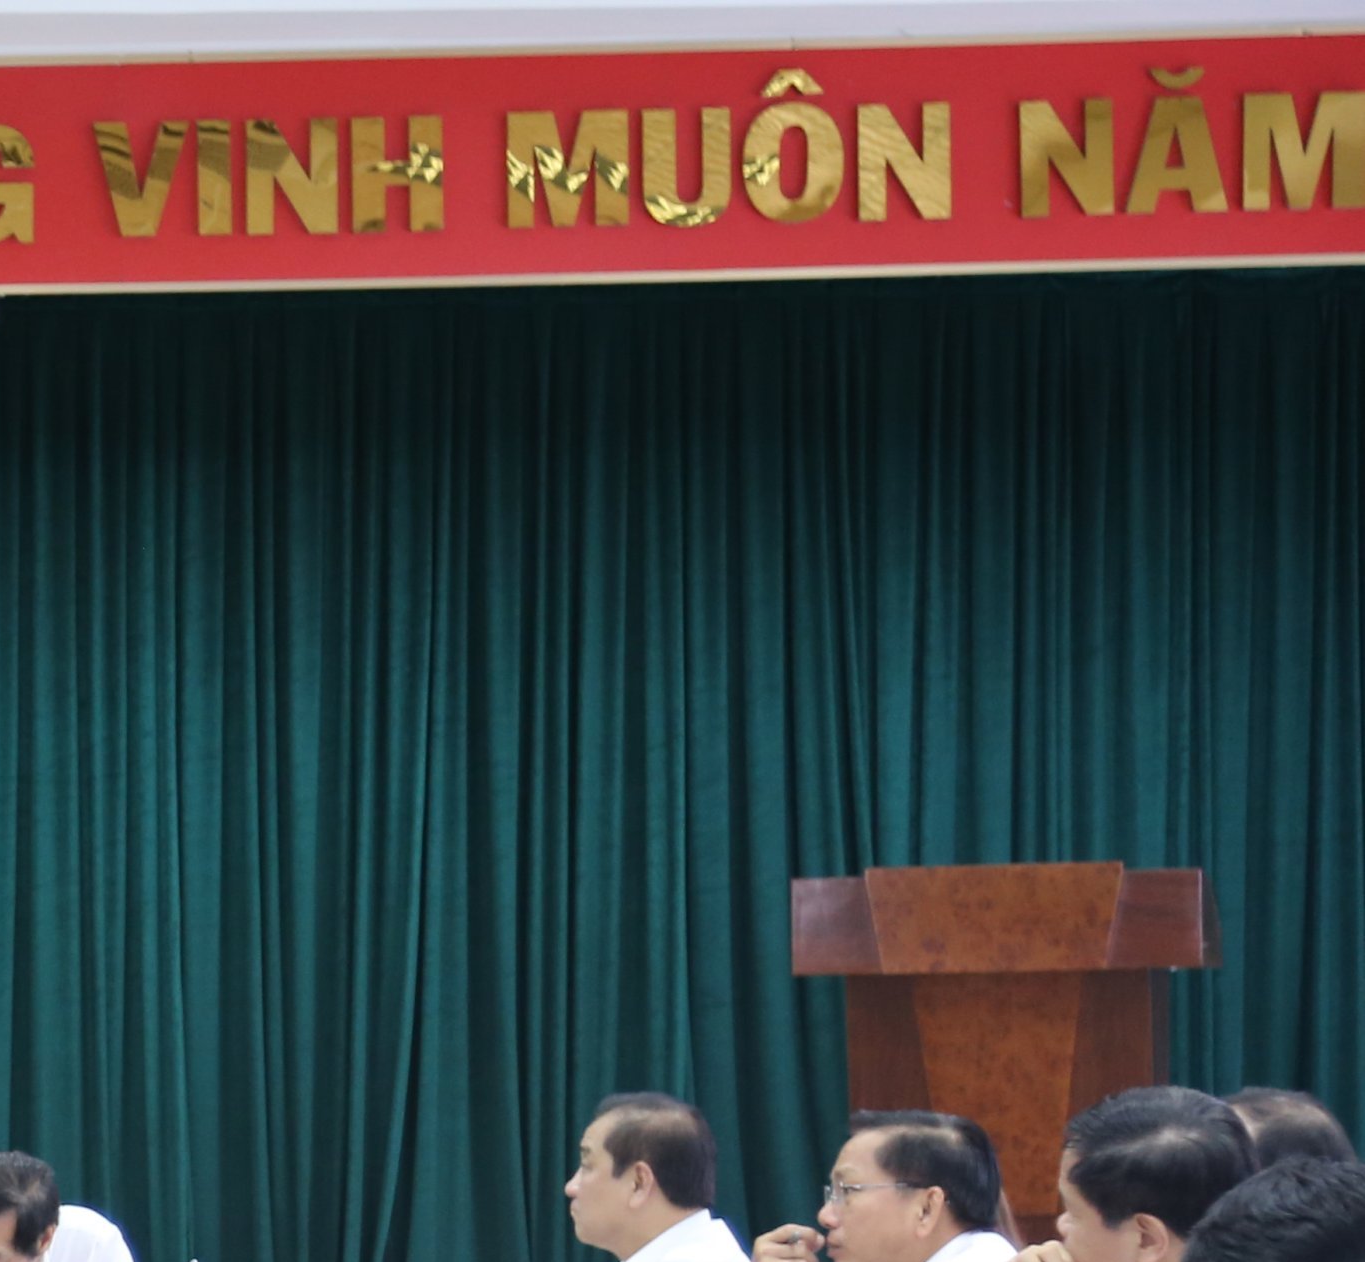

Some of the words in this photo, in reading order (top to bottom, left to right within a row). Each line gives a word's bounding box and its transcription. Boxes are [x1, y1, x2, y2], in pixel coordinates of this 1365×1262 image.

[93, 115, 445, 238] VINH
[504, 68, 952, 229] MUÔN
[1019, 66, 1365, 219] NĂM
